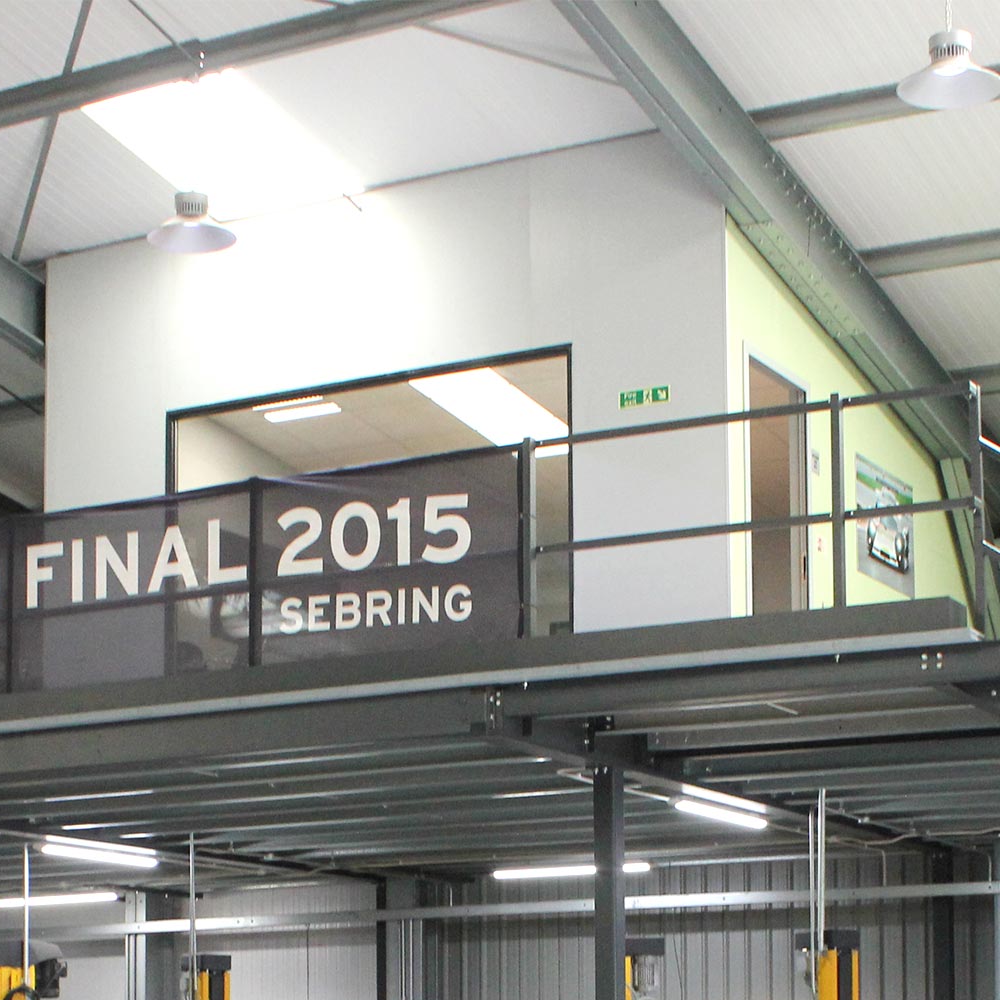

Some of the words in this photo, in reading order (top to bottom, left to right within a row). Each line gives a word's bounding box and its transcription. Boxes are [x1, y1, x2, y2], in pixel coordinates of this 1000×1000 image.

[26, 519, 248, 609] FINAL
[277, 493, 472, 578] 2015
[280, 584, 472, 635] SEBRING
